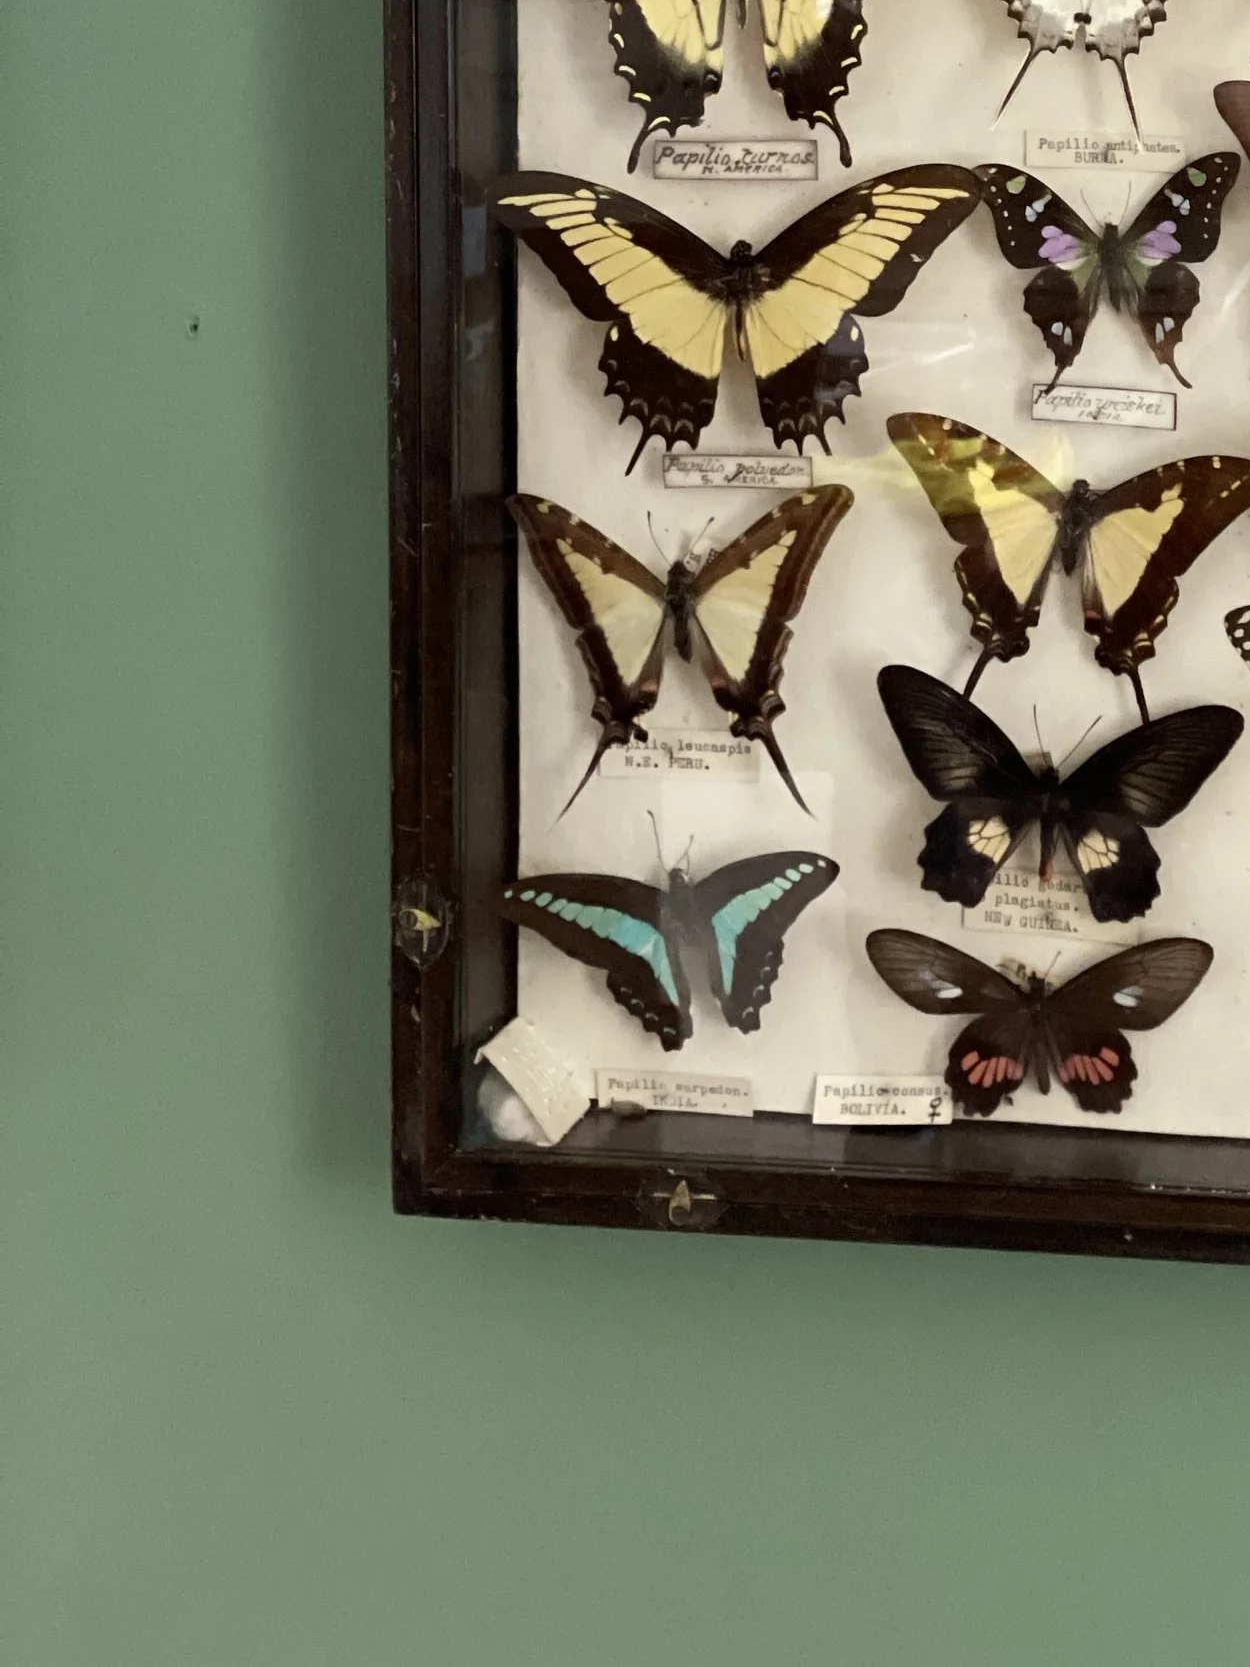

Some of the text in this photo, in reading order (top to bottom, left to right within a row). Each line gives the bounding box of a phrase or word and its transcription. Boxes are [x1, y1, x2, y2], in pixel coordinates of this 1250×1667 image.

[1038, 137, 1099, 152] Papilio
[654, 143, 732, 172] Papilio
[668, 758, 711, 771] PERU.
[994, 893, 1079, 912] plagiatus.
[1018, 915, 1080, 934] GUINEA.
[608, 1077, 749, 1098] Papilio sarpedon.
[824, 1083, 884, 1101] Papilio
[840, 1101, 907, 1116] BOLIVIA.
